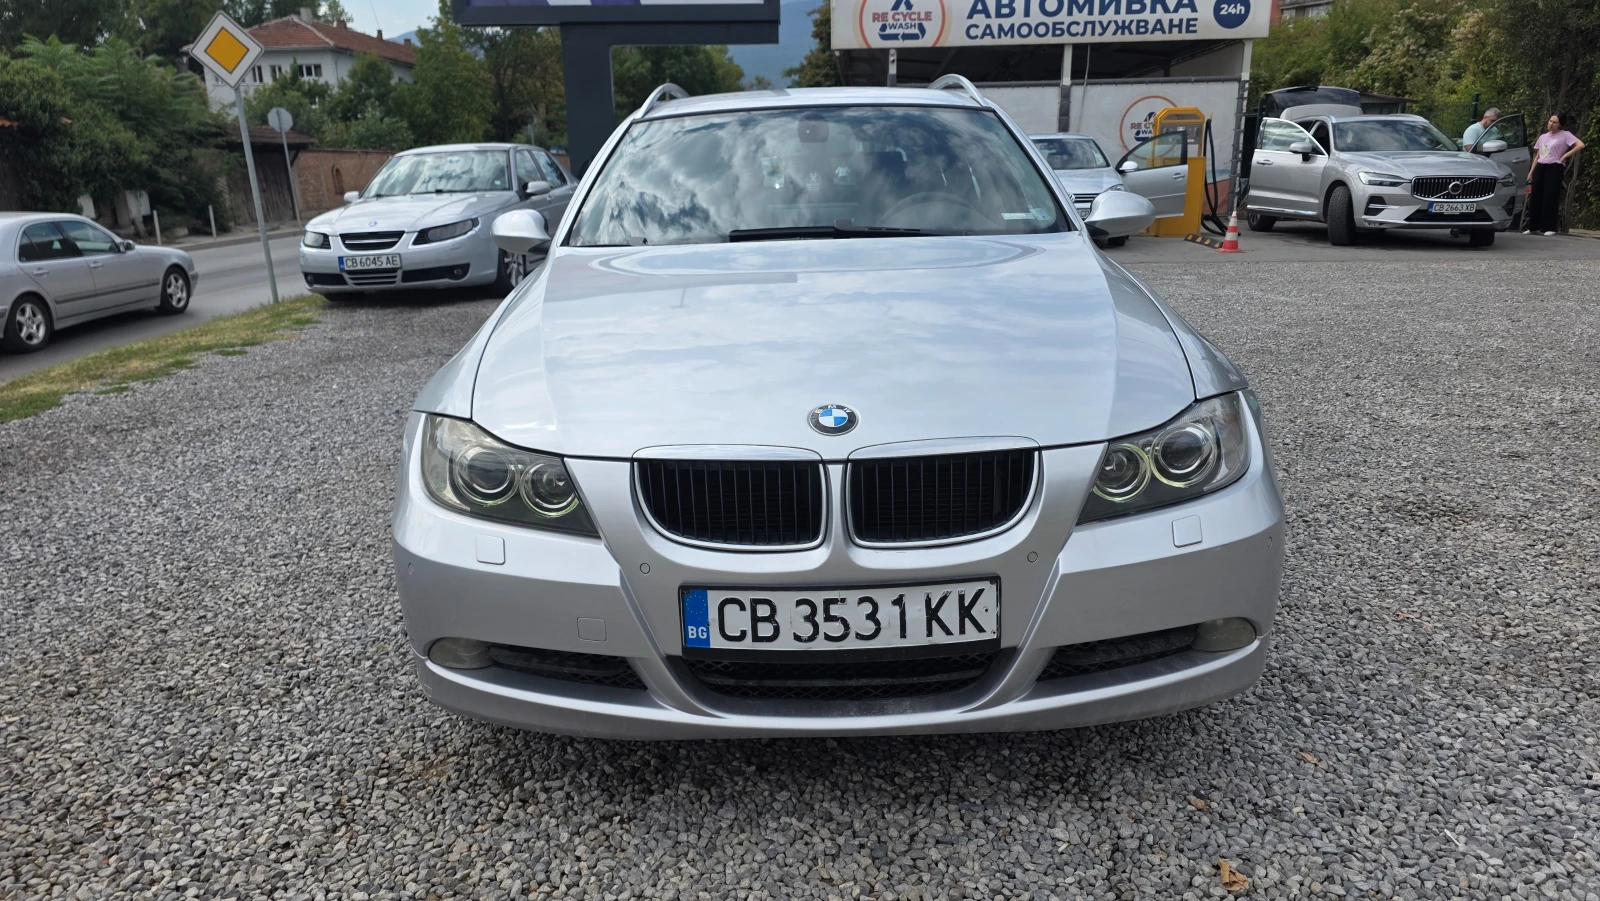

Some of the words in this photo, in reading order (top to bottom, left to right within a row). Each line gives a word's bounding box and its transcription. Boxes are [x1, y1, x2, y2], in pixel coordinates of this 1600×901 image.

[1219, 3, 1245, 15] 24h
[872, 12, 888, 23] RE
[891, 11, 932, 22] CYCLE
[888, 22, 916, 30] WASH
[965, 18, 1198, 40] САМООБСЛУЖВАНЕ
[360, 256, 383, 267] 6045
[386, 255, 399, 266] AE
[717, 596, 781, 643] CB
[792, 593, 907, 642] 3531
[924, 588, 987, 637] KK
[688, 625, 707, 639] BG
